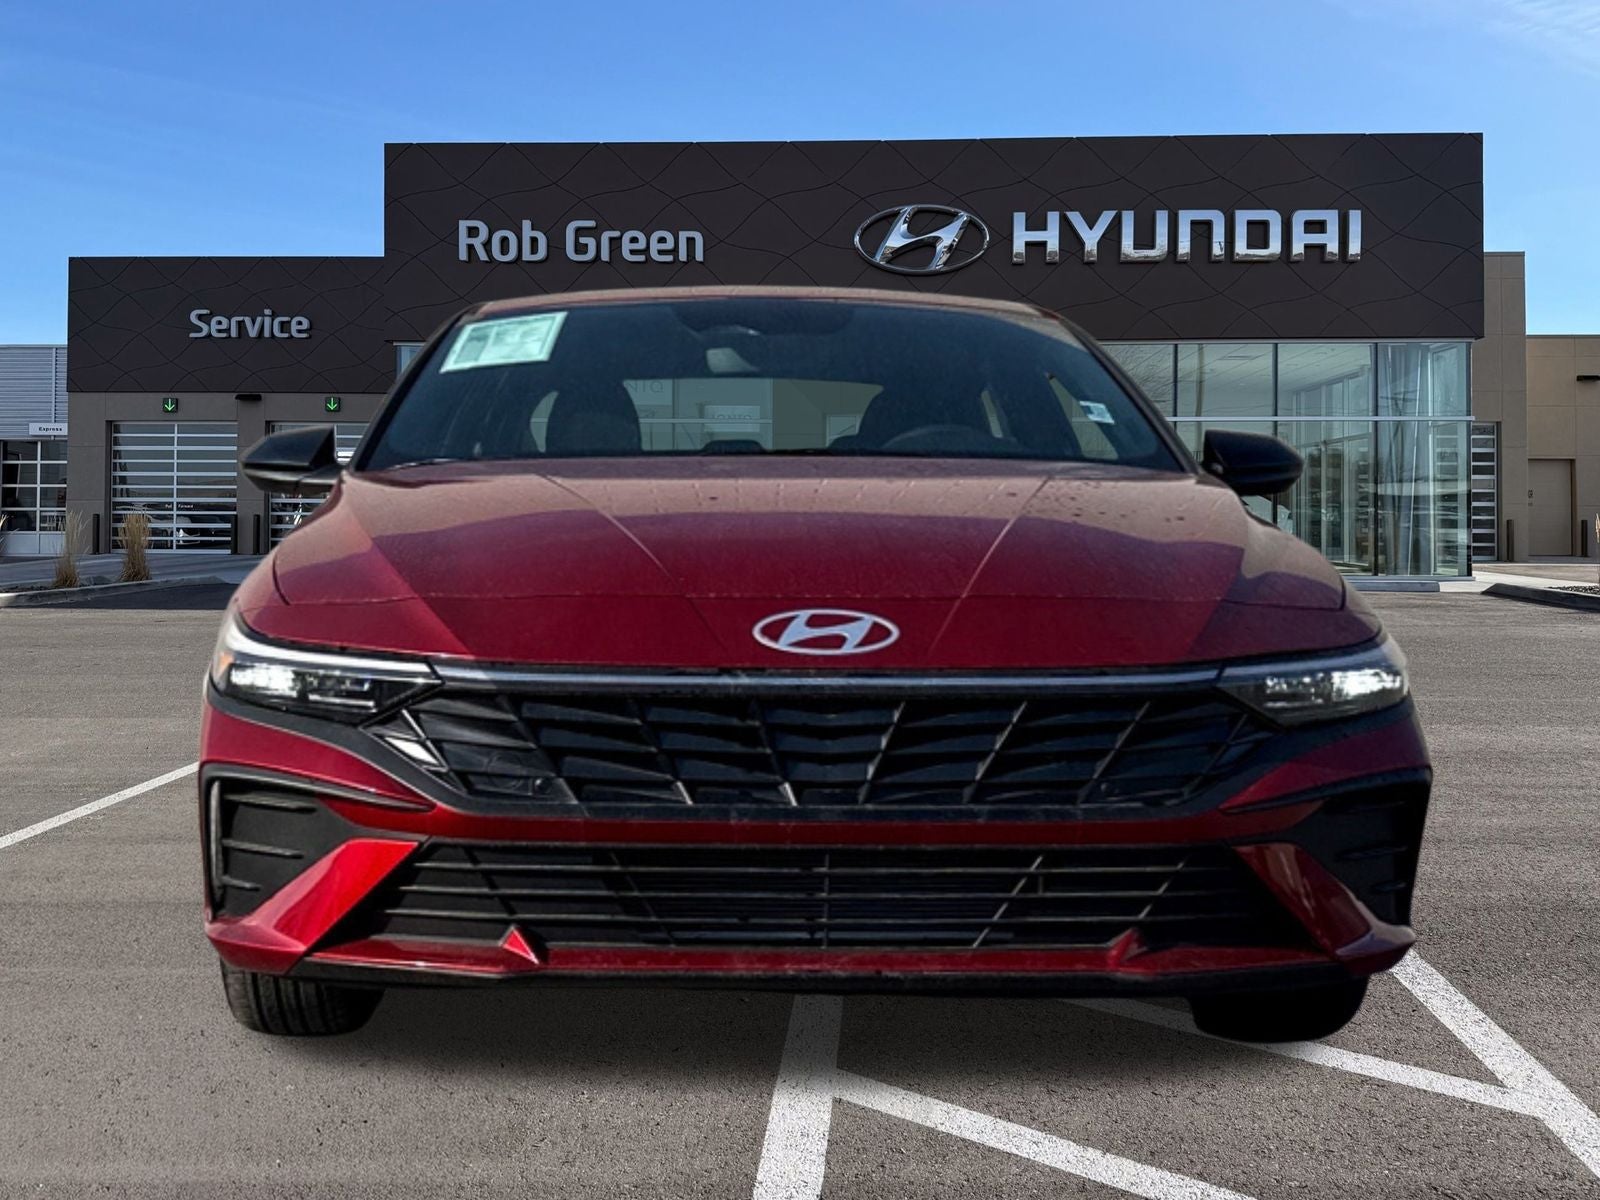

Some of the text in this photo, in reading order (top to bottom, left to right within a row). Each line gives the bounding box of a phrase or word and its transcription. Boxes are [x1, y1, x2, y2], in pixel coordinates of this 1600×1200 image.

[458, 219, 704, 262] Rob Green
[1011, 210, 1362, 263] HYUNDAI
[189, 309, 310, 338] Service
